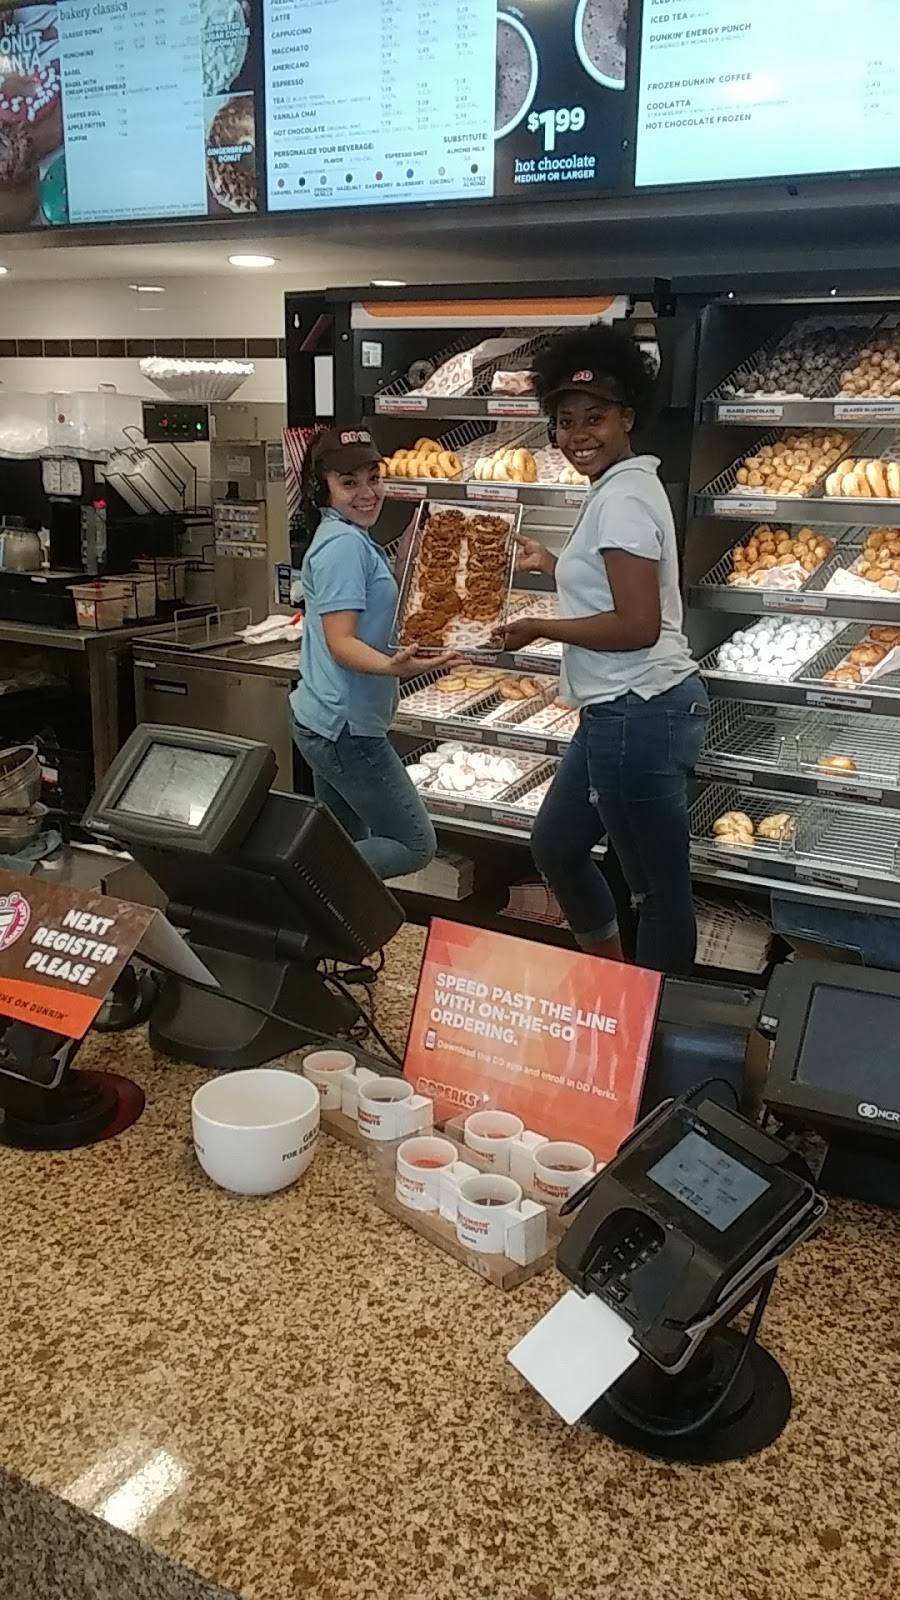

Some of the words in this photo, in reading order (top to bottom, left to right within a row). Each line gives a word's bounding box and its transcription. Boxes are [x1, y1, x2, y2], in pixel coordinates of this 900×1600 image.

[60, 8, 91, 20] bakery
[92, 2, 128, 16] classics
[271, 13, 291, 23] LATTE
[650, 14, 671, 25] ICED
[671, 12, 690, 21] TEA
[271, 27, 313, 39] CAPPUCCINO
[649, 30, 685, 43] DUNKIN'
[685, 26, 720, 39] ENERGY
[720, 22, 753, 34] PUNCH
[272, 44, 310, 55] MACCHIATO
[272, 61, 310, 72] AMERICANO
[272, 78, 304, 88] ESPRESSO
[647, 80, 682, 91] FROZEN
[682, 76, 717, 88] DUNKIN'
[718, 72, 753, 84] COFFEE
[273, 97, 285, 105] TEA
[646, 99, 692, 111] COOLATTA
[273, 112, 301, 121] VANILLA
[301, 110, 317, 118] CHAI
[645, 121, 663, 131] HOT
[664, 116, 715, 128] CHOCOLATE
[716, 113, 752, 124] FROZEN
[273, 129, 286, 137] HOT
[287, 126, 326, 136] CHOCOLATE
[206, 143, 252, 156] GINGERBREAD
[273, 147, 318, 158] PERSONALIZE
[318, 145, 337, 155] YOUR
[384, 152, 412, 160] ESPRESSO
[218, 153, 242, 163] DONUT
[323, 157, 345, 165] FLAVOR
[514, 158, 537, 173] hot
[537, 153, 597, 171] chocolate
[513, 174, 547, 185] MEDIUM
[546, 171, 560, 181] OR
[561, 169, 596, 181] LARGER
[62, 909, 116, 936] NEXT
[30, 926, 119, 965] REGISTER
[24, 951, 97, 986] PLEASE
[14, 998, 30, 1008] ON
[435, 972, 488, 999] SPEED
[490, 985, 536, 1011] PAST
[538, 999, 574, 1022] THE
[576, 1008, 620, 1036] LINE
[434, 989, 477, 1013] WITH
[477, 1002, 577, 1043] ON-THE-GO
[429, 1009, 519, 1047] ORDERING.
[437, 1040, 476, 1060] Download
[477, 1050, 491, 1063] the
[491, 1055, 505, 1068] DD
[505, 1060, 523, 1074] app
[524, 1065, 541, 1078] and
[541, 1071, 566, 1087] enroll
[576, 1080, 591, 1094] DD
[592, 1085, 618, 1102] Perks.
[877, 1108, 900, 1123] NCR
[281, 1149, 298, 1162] FOR
